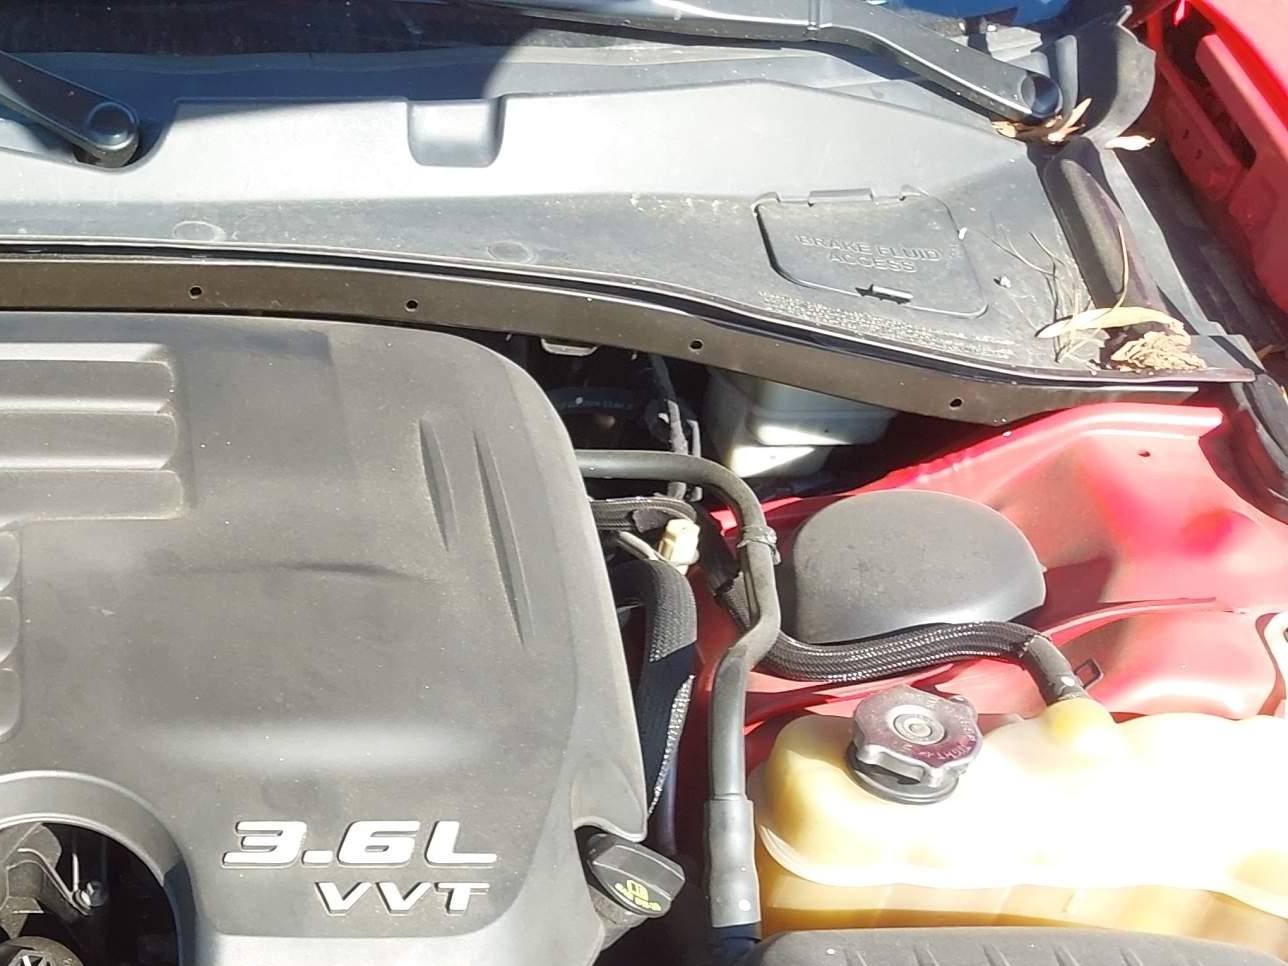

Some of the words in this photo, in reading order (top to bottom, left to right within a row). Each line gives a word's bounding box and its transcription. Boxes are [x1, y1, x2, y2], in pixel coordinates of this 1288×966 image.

[795, 234, 873, 255] BRAKE
[875, 243, 943, 262] FLUID
[828, 252, 918, 273] ACCESS
[221, 819, 499, 868] 3.6L
[314, 881, 491, 916] VVT
